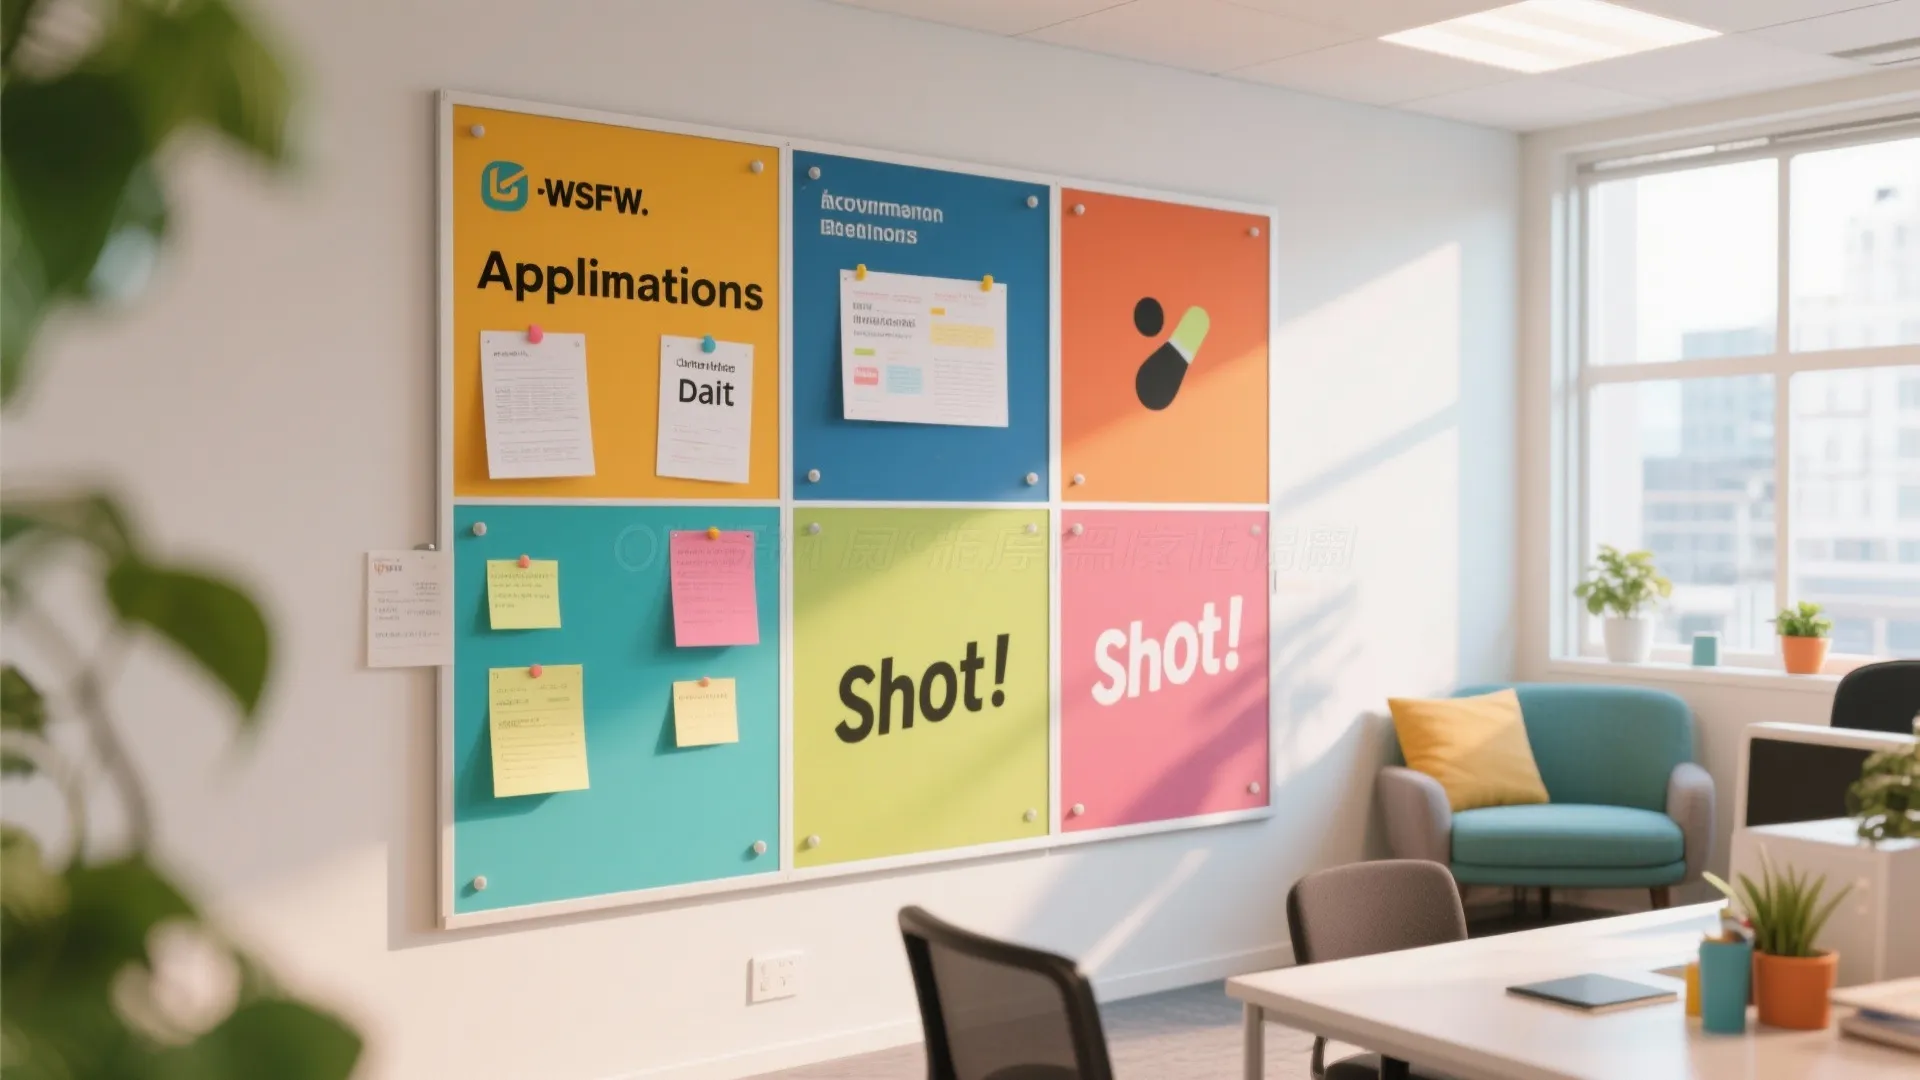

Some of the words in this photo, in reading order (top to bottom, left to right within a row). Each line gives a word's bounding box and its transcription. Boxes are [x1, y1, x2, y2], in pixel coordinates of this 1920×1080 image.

[477, 250, 764, 311] Applimations
[678, 378, 735, 407] Dait
[834, 633, 1010, 744] Shot!
[1091, 594, 1243, 706] Shot!
